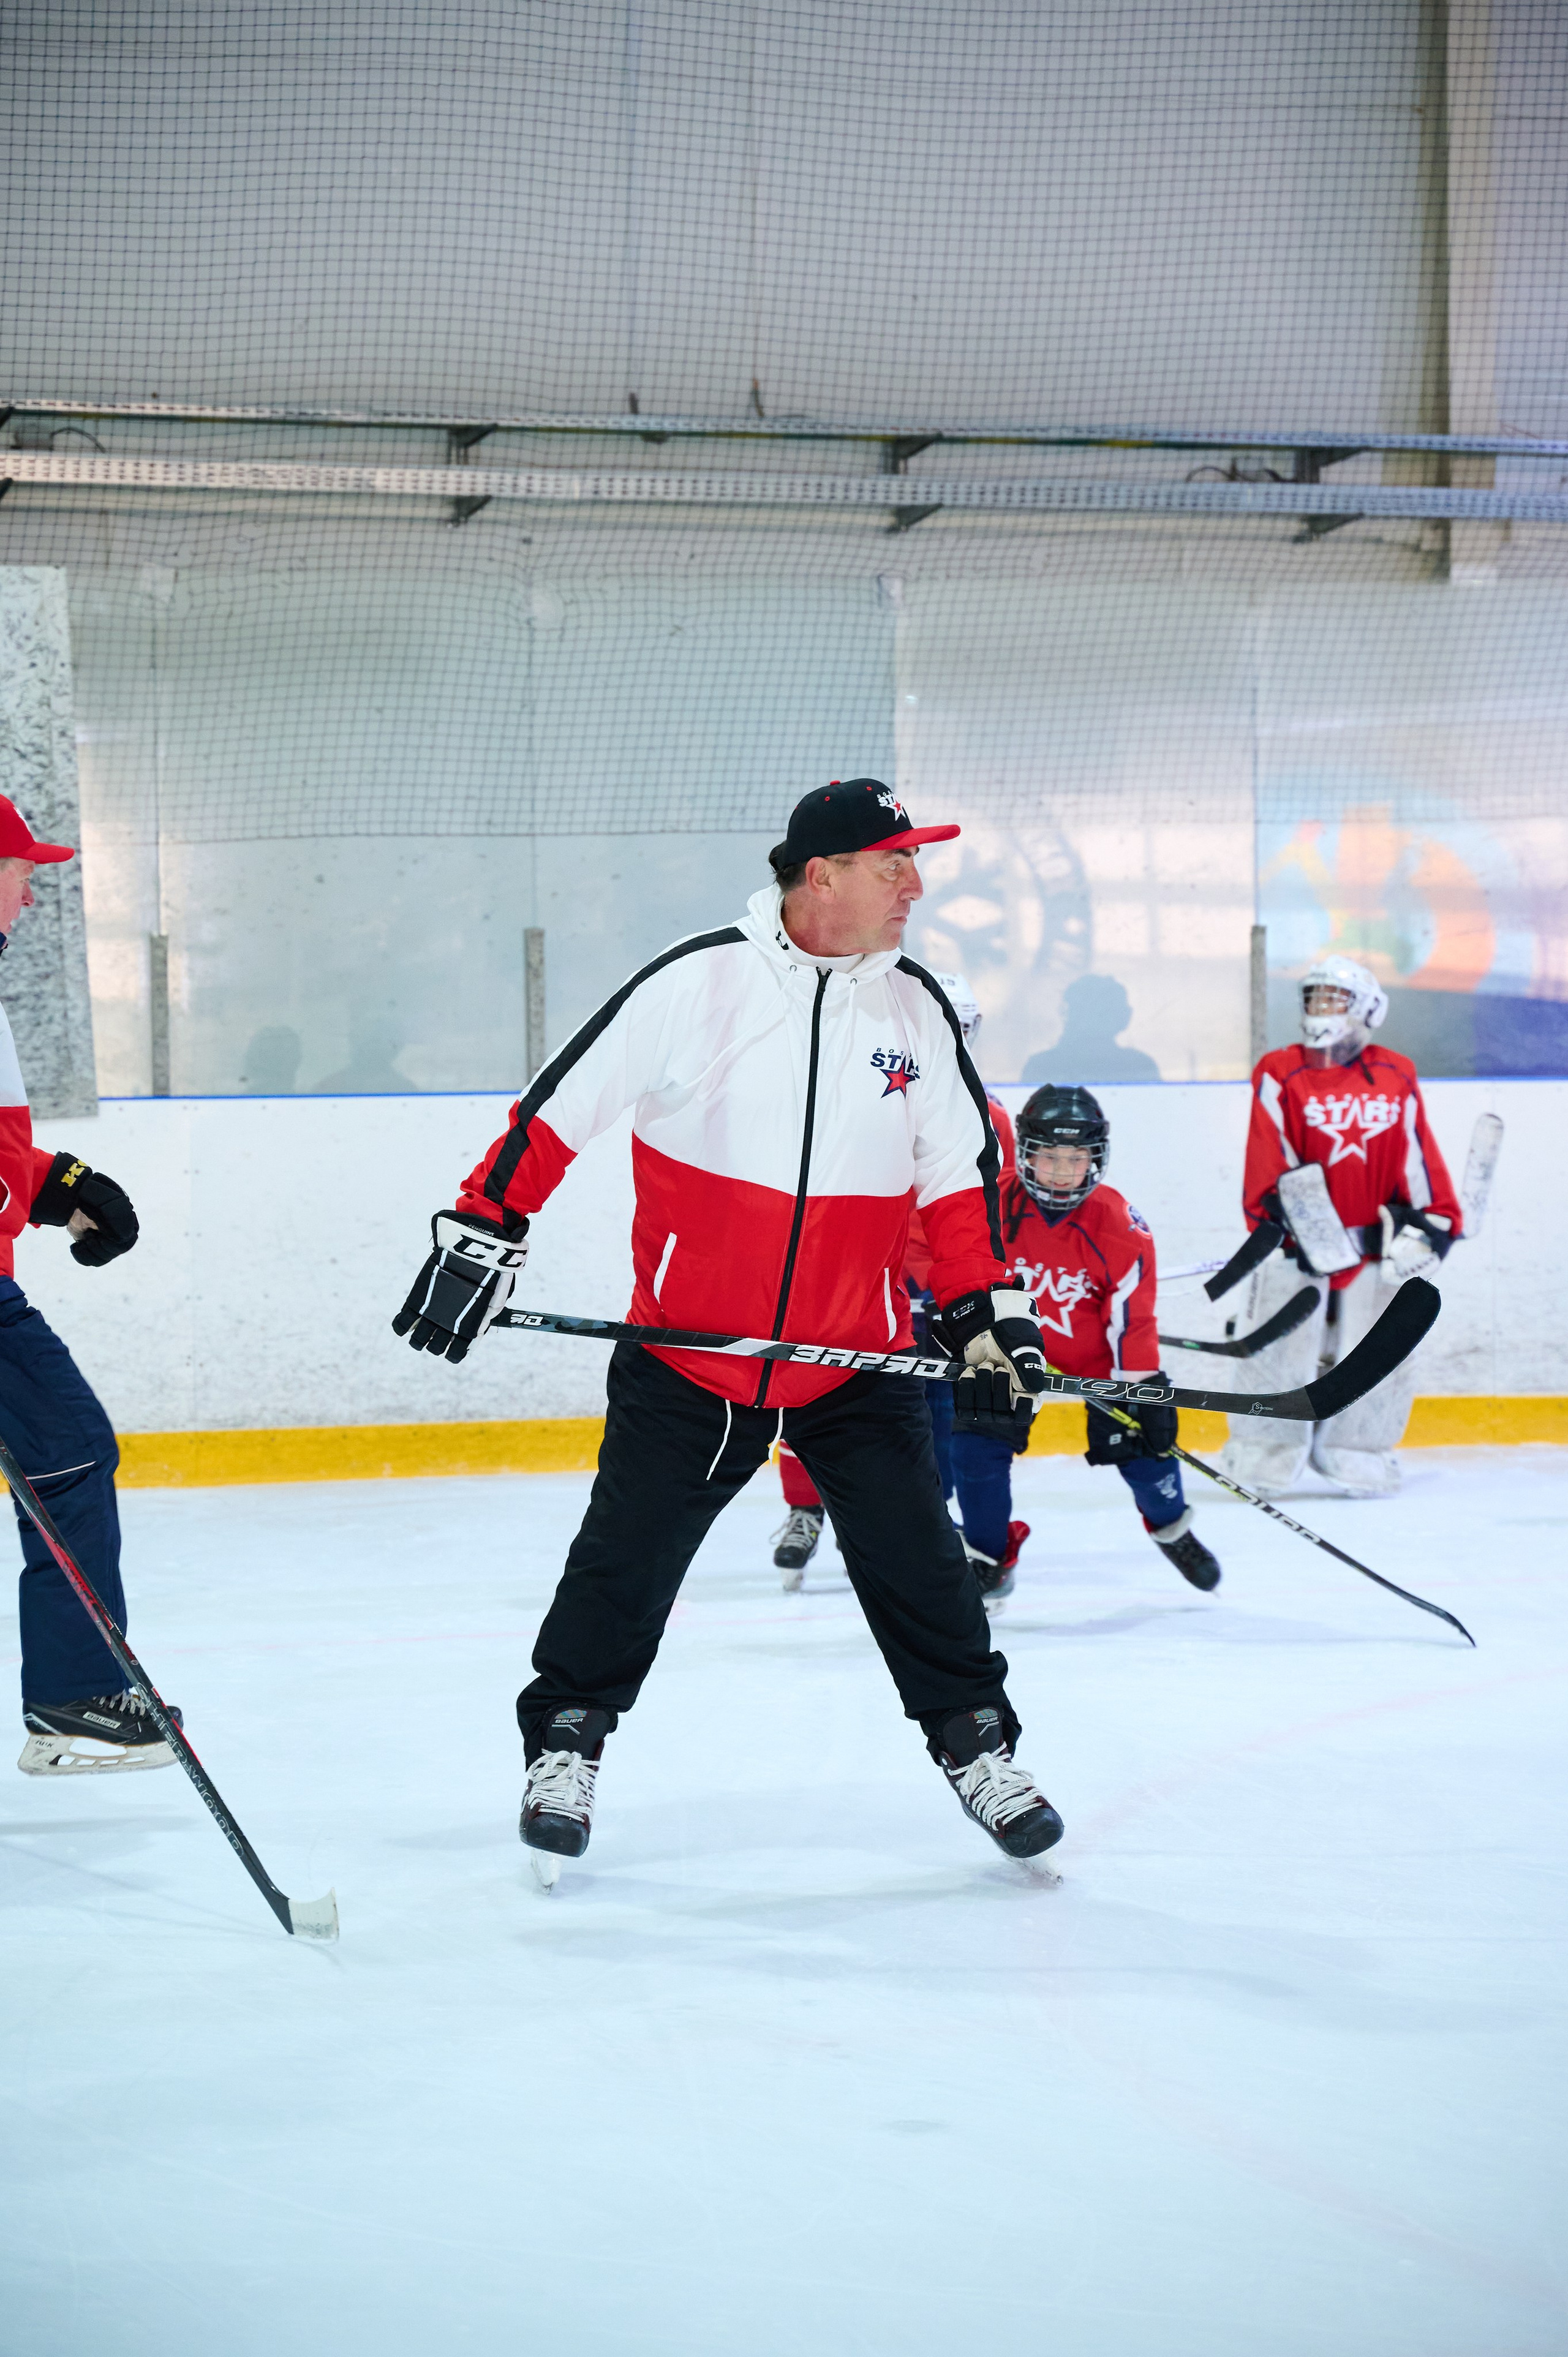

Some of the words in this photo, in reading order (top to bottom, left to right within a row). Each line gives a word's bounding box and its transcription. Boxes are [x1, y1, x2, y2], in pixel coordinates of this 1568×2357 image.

[468, 1223, 495, 1237] PENGUINS
[453, 1233, 528, 1268] CC
[1044, 1376, 1175, 1403] T90
[86, 1713, 117, 1728] BAUER
